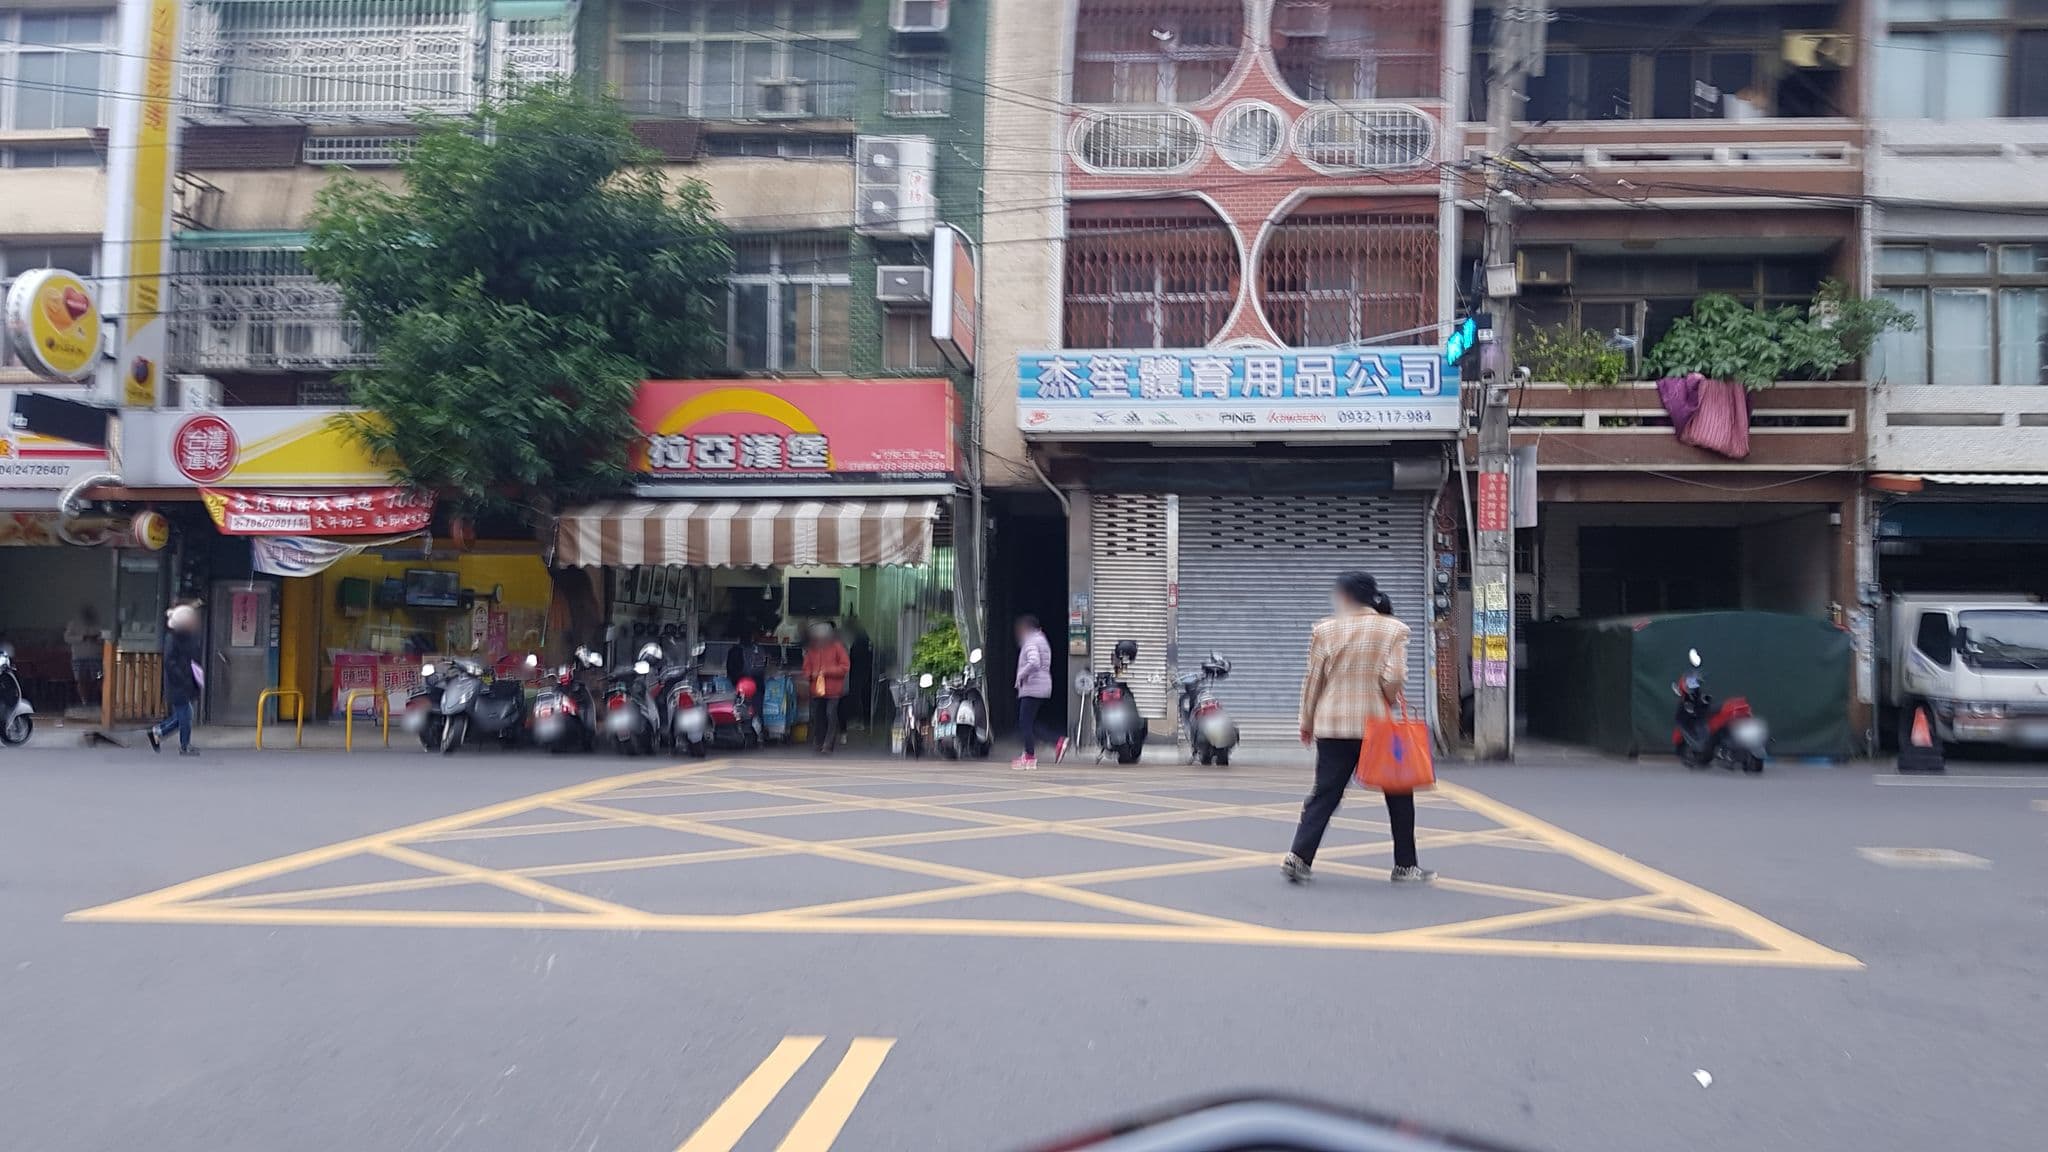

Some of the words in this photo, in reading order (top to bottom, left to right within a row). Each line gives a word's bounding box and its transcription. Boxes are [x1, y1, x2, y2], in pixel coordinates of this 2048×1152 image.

[1035, 355, 1442, 400] 杰笙體育用品公司
[1218, 411, 1257, 424] PING
[1337, 409, 1433, 424] 0932-117-984
[648, 432, 831, 470] 拉亞漢堡
